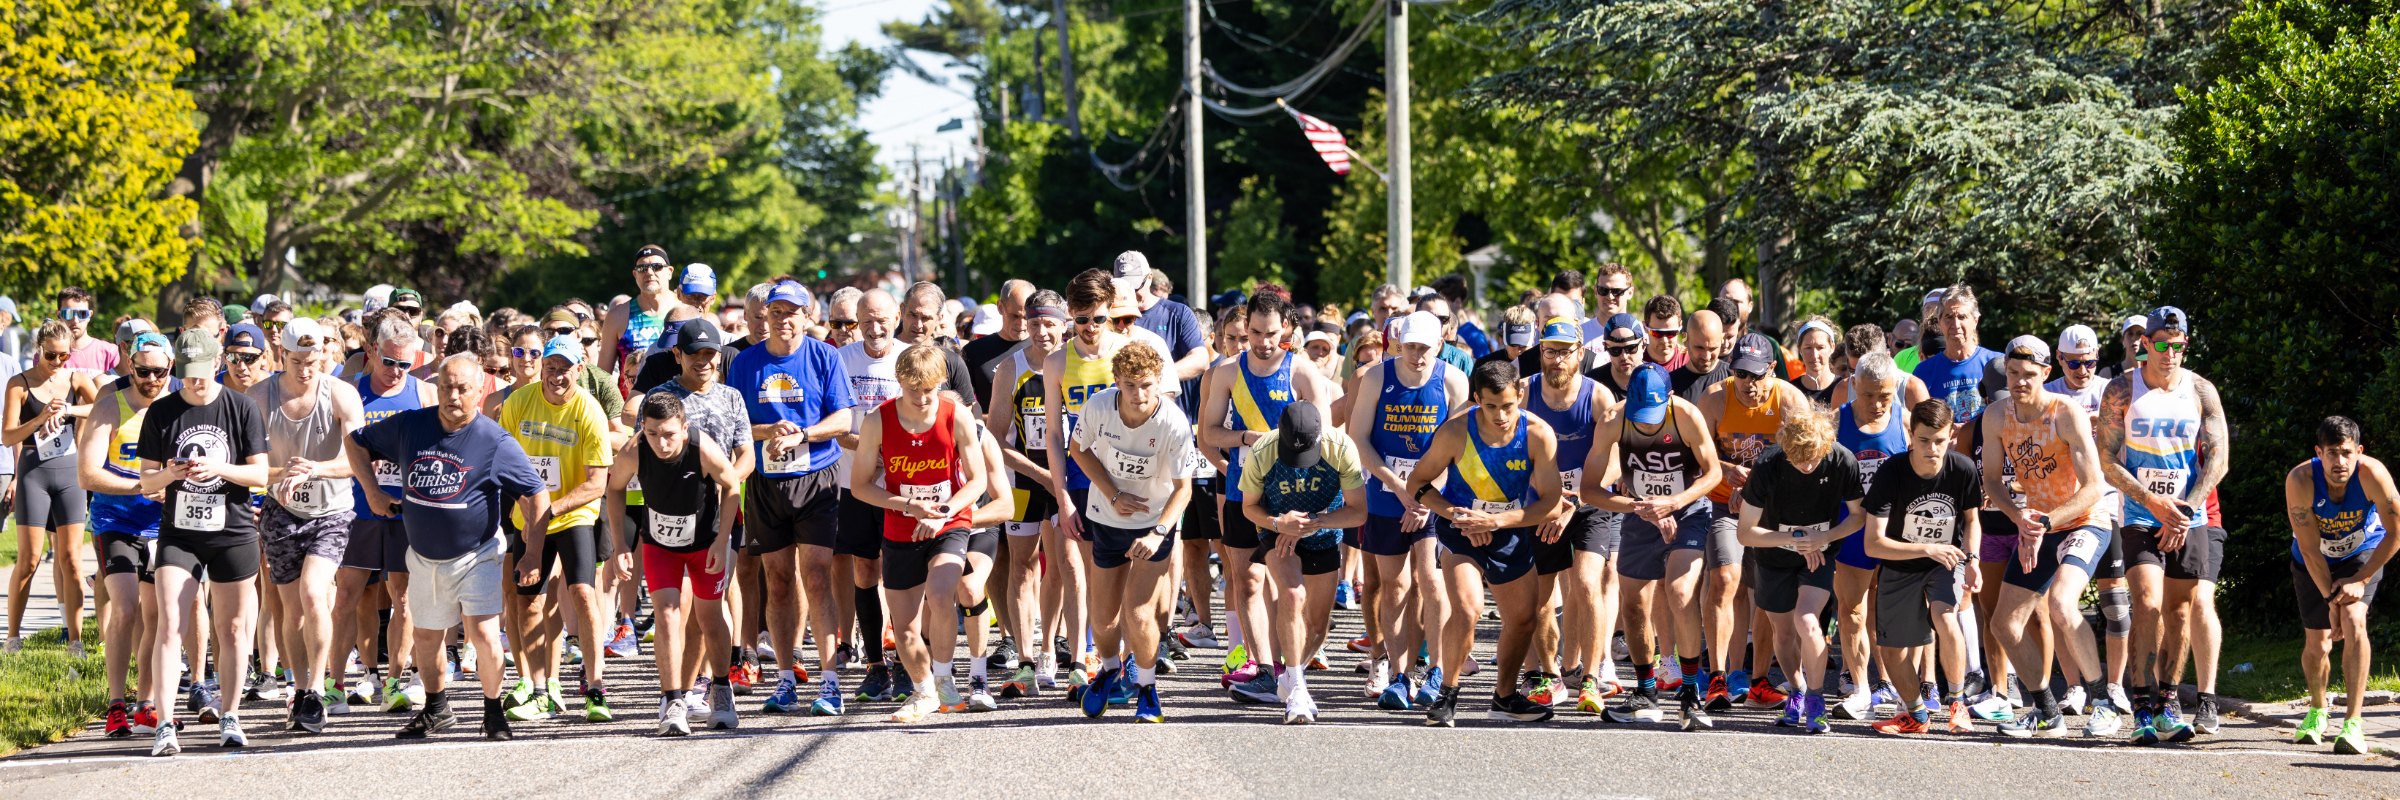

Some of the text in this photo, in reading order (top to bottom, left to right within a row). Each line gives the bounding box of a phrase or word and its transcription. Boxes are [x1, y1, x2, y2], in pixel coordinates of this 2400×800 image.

[761, 372, 800, 389] NORTHPORT
[1269, 389, 1288, 401] SRC
[1385, 404, 1439, 414] SAYVILLE
[1386, 414, 1437, 423] RUNNING
[1383, 423, 1439, 433] COMPANY
[2131, 417, 2195, 438] SRC
[175, 424, 229, 445] KEITH NINTZEL
[204, 439, 219, 449] 5K
[436, 450, 448, 458] High
[448, 453, 465, 464] School
[2007, 436, 2033, 468] Long
[541, 457, 552, 467] 5k
[889, 455, 949, 479] Flyers
[1137, 457, 1150, 465] 5k
[1505, 459, 1527, 471] SRC
[1627, 451, 1684, 471] ASC
[2035, 453, 2058, 479] Crew
[414, 463, 429, 472] The
[1118, 461, 1145, 475] 122
[407, 470, 468, 488] CHRISSY
[1564, 471, 1575, 480] 5k
[1663, 473, 1675, 482] 5k
[2168, 471, 2180, 480] 5k
[182, 480, 227, 494] MEMORIAL
[302, 482, 314, 490] 5k
[429, 485, 460, 495] GAMES
[932, 484, 943, 493] 5k
[1645, 483, 1672, 496] 206
[2148, 482, 2175, 495] 456
[206, 495, 218, 504] 5k
[1906, 494, 1926, 514] KEITH
[1505, 501, 1516, 511] 5k
[1932, 505, 1947, 514] 5K
[186, 505, 213, 520] 353
[675, 516, 688, 525] 5k
[657, 523, 684, 538] 277
[1916, 526, 1943, 539] 126
[2346, 534, 2356, 542] 5k
[2060, 538, 2085, 551] 228
[2328, 542, 2354, 552] 457
